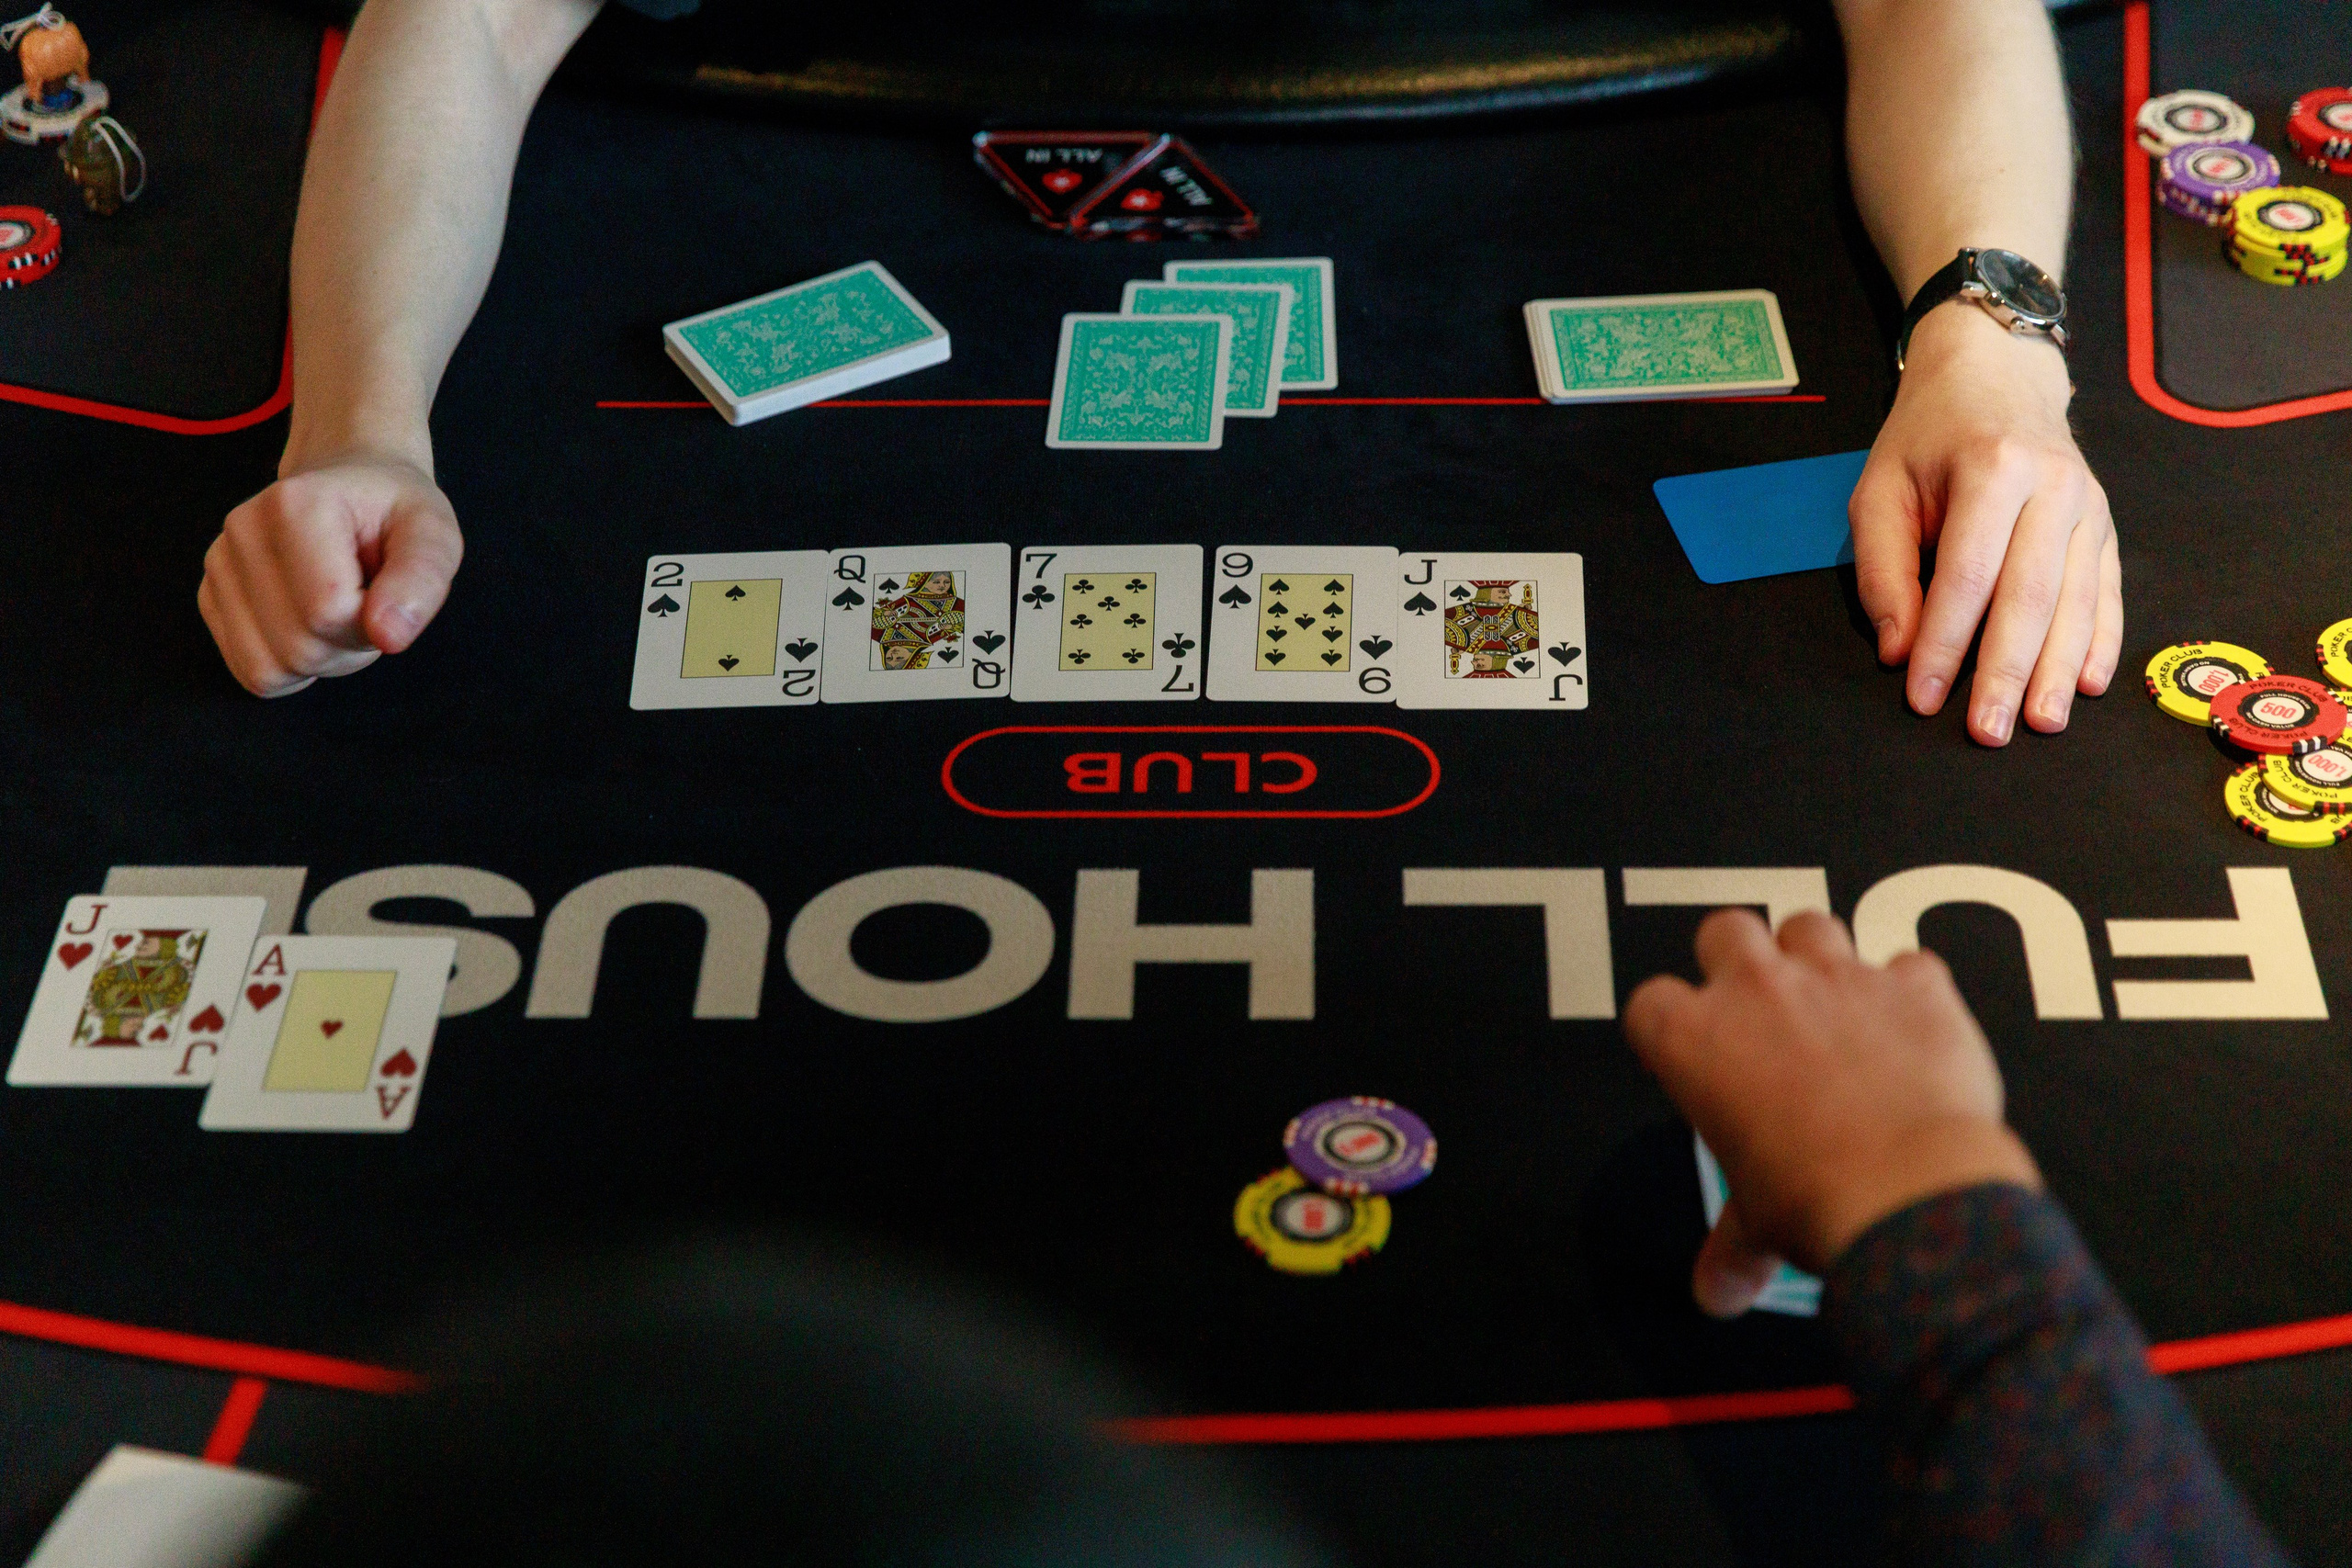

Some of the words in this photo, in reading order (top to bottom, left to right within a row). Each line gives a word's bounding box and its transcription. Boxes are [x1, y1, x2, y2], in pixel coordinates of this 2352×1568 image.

[650, 562, 684, 588] 2
[833, 555, 866, 584] Q
[1025, 553, 1057, 579] 7
[1221, 552, 1254, 578] 9
[1404, 558, 1438, 585] J
[972, 658, 1006, 689] Q
[1161, 664, 1194, 693] 7
[1358, 667, 1392, 694] 9
[2159, 661, 2174, 689] POKER
[2170, 649, 2202, 662] CLUB
[782, 670, 817, 697] 2
[1548, 673, 1583, 702] J
[2248, 681, 2296, 690] POKER
[2298, 684, 2328, 703] CLUB
[2260, 702, 2297, 719] 500
[1063, 751, 1318, 794] CLUB
[2272, 760, 2292, 784] CLUB
[2291, 783, 2338, 799] POKER
[66, 904, 108, 935] J
[253, 943, 287, 976] A
[175, 1041, 218, 1075] J
[376, 1085, 411, 1121] A
